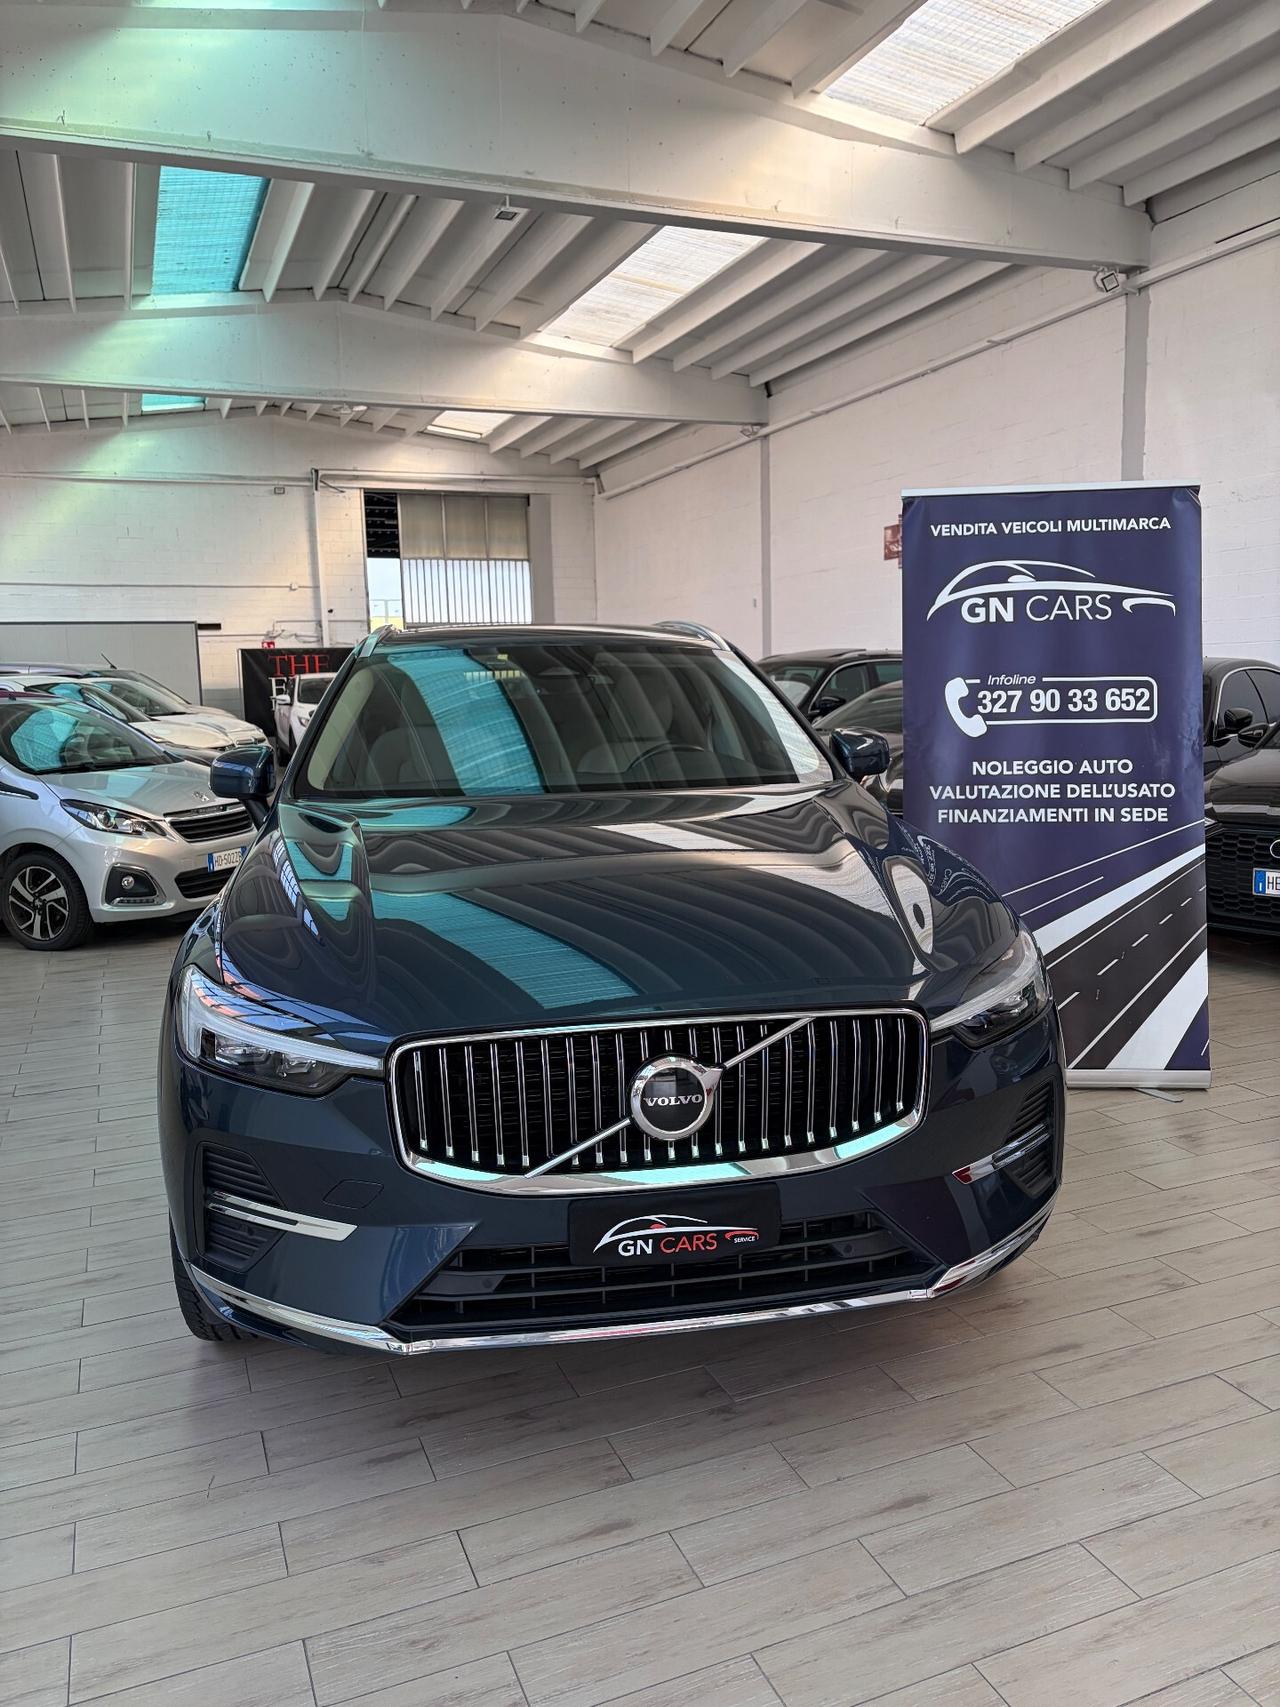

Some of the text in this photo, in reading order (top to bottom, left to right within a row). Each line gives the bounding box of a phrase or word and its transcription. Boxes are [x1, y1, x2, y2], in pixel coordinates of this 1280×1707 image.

[930, 516, 1171, 537] VENDITA VEICOLI MULTIMARCA
[960, 594, 1112, 623] GN CARS
[987, 674, 1036, 686] Infoline
[977, 688, 1150, 713] 327 90 33 652
[972, 759, 1133, 776] NOLEGGIO AUTO
[930, 782, 1176, 800] VALUTAZIONE DELL'USATO
[938, 807, 1169, 823] FINANZIAMENTI IN SEDE
[643, 1094, 703, 1107] VOLVO
[618, 1233, 756, 1257] GN CARS SERVICE
